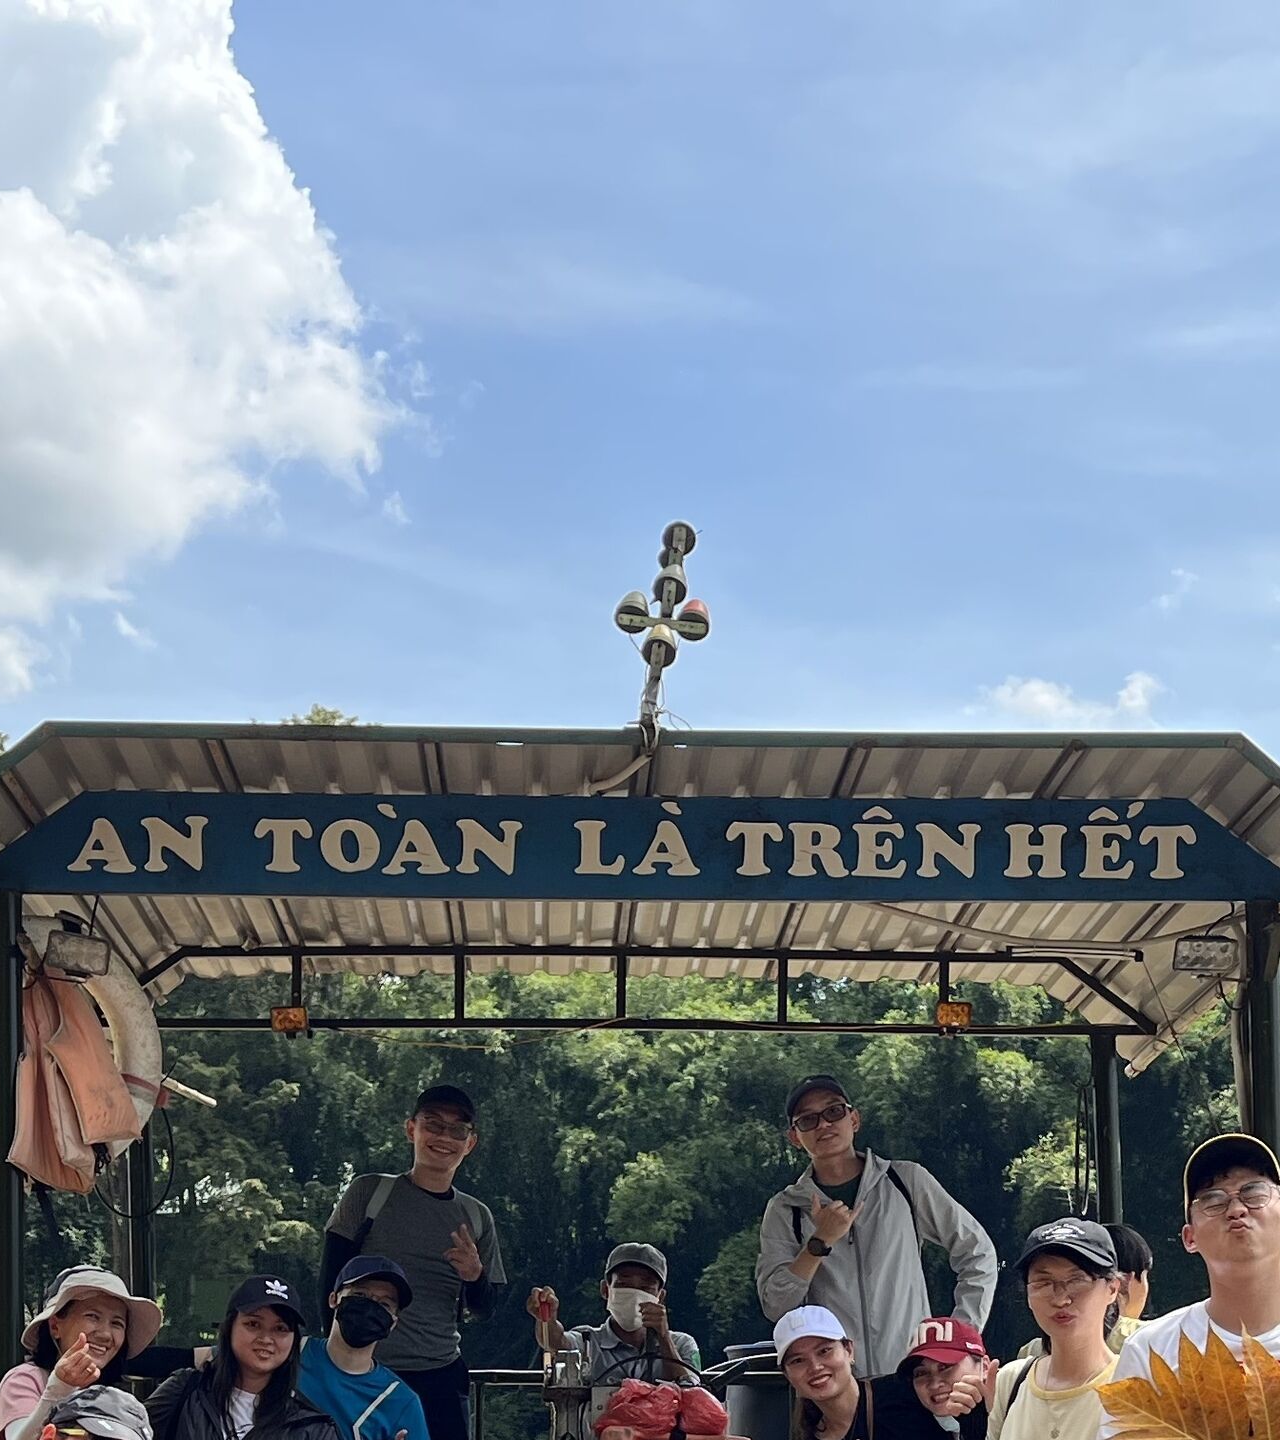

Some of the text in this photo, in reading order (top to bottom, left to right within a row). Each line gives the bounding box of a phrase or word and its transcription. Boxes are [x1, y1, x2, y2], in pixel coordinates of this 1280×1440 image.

[66, 800, 1198, 880] AN TOÀN LÀ TRÊN HẾT
